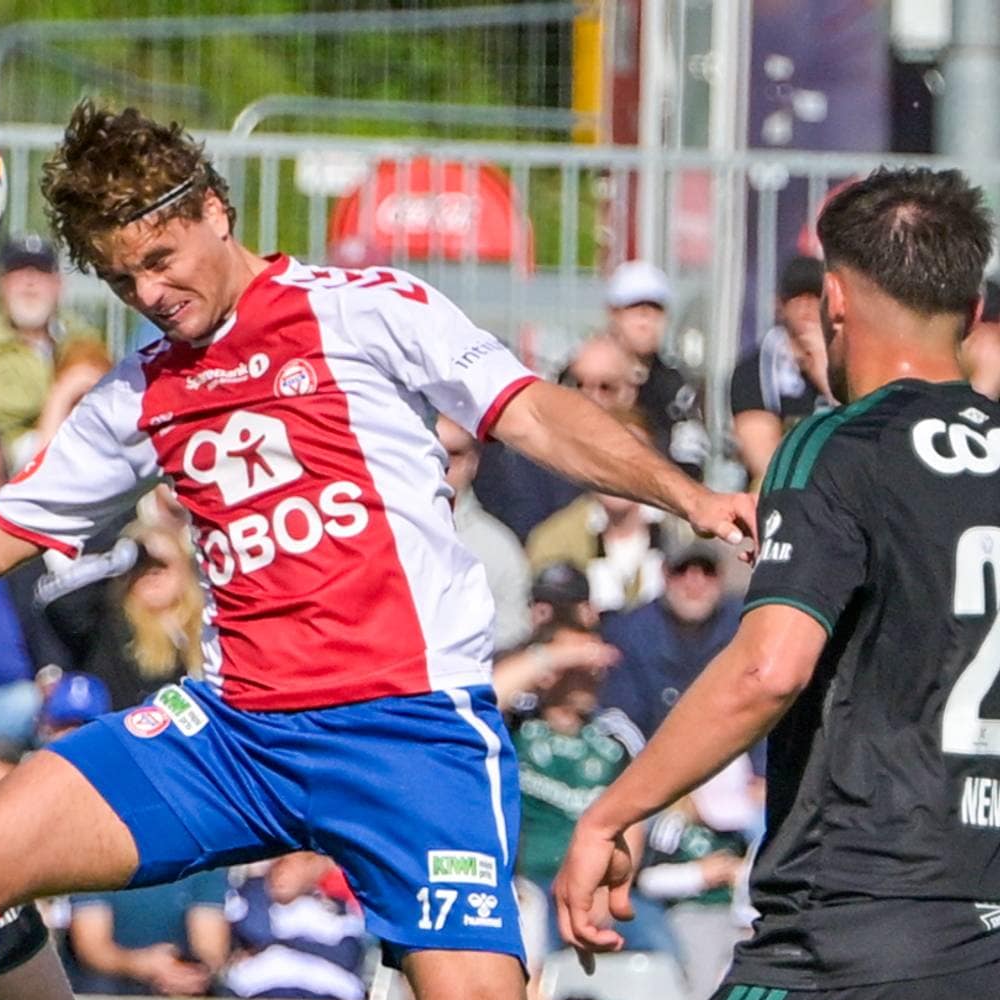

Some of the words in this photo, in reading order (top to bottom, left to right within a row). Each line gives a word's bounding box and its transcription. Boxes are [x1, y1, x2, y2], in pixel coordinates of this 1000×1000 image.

[204, 480, 369, 586] OBOS
[433, 856, 477, 876] KIWI
[416, 887, 458, 930] 17
